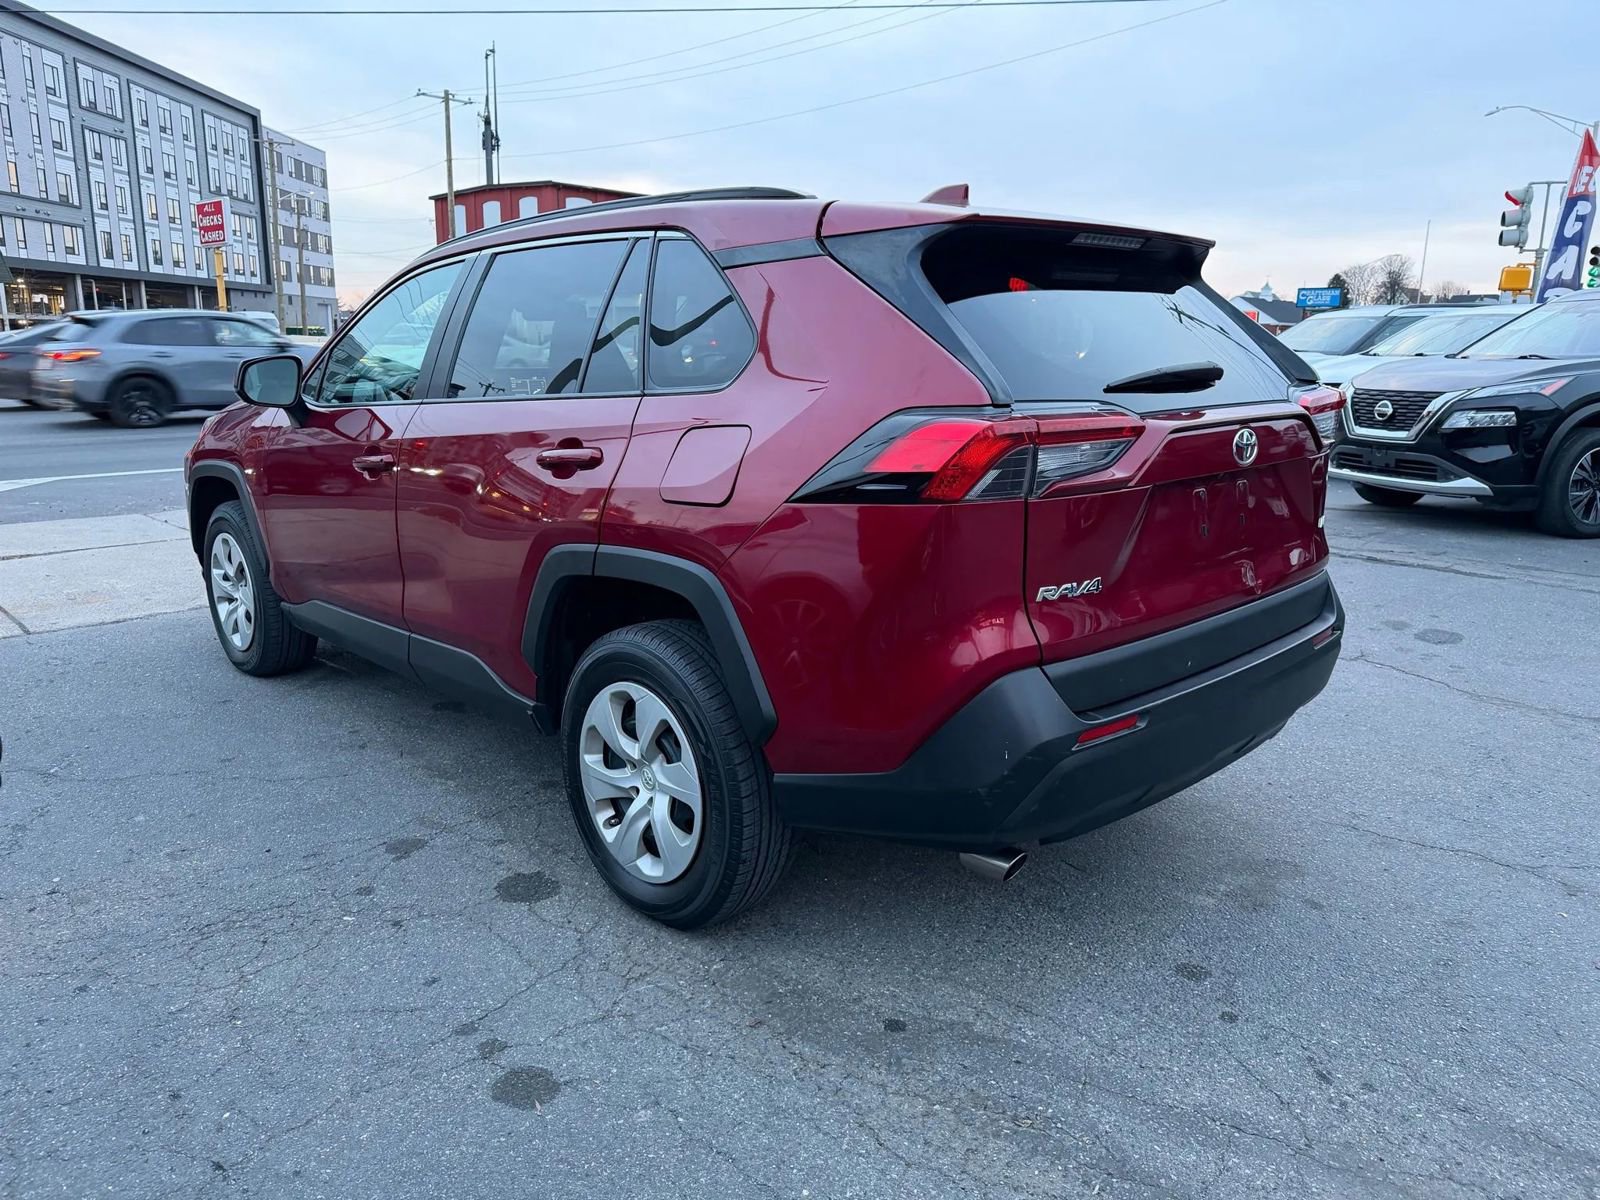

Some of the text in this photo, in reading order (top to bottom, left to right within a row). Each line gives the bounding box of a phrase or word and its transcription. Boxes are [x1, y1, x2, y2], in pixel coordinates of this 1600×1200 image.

[203, 203, 215, 212] ALL
[198, 214, 223, 227] CHECKS
[200, 230, 224, 243] CASHED
[1035, 576, 1102, 602] RAV4
